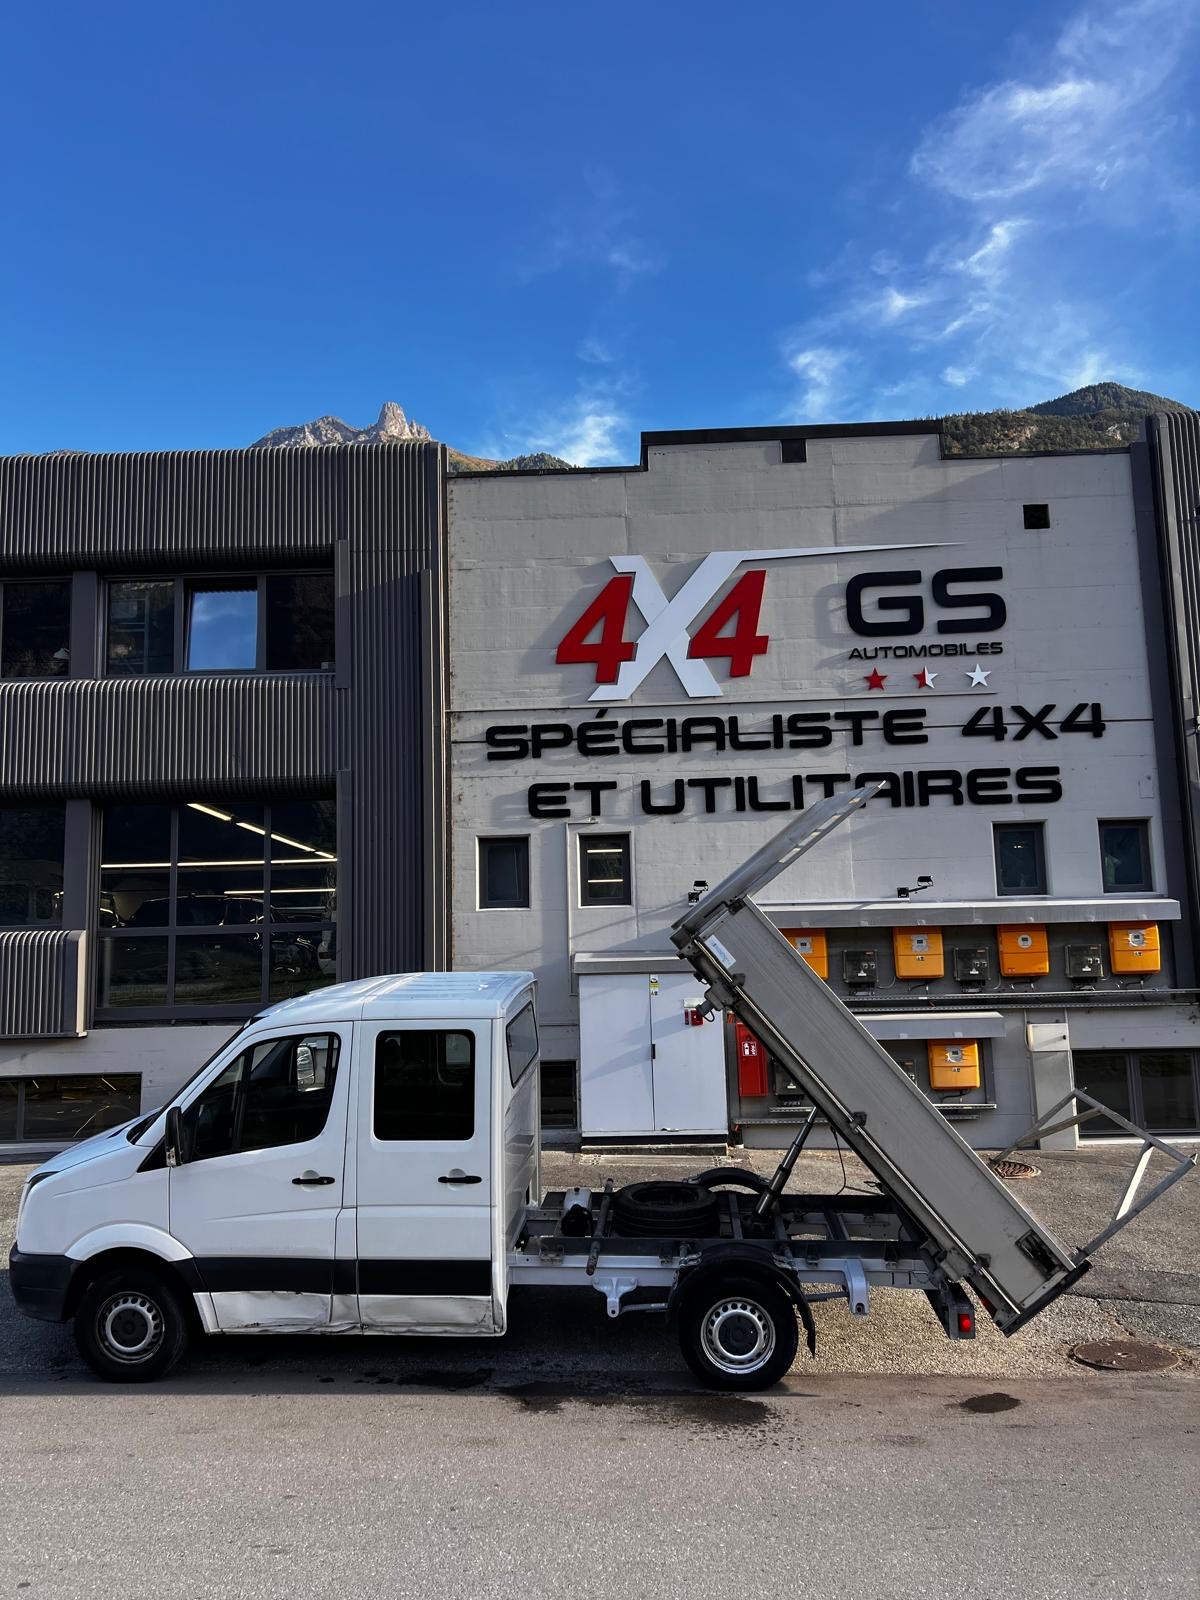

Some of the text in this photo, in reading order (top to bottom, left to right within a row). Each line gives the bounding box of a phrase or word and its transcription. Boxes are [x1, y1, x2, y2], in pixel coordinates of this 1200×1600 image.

[556, 550, 769, 700] 4X4
[845, 566, 1007, 637] GS
[848, 641, 1003, 660] AUTOMOBILES
[485, 702, 1106, 760] SPÉCIALISTE 4X4
[528, 766, 1063, 818] ET UTILITAIRES
